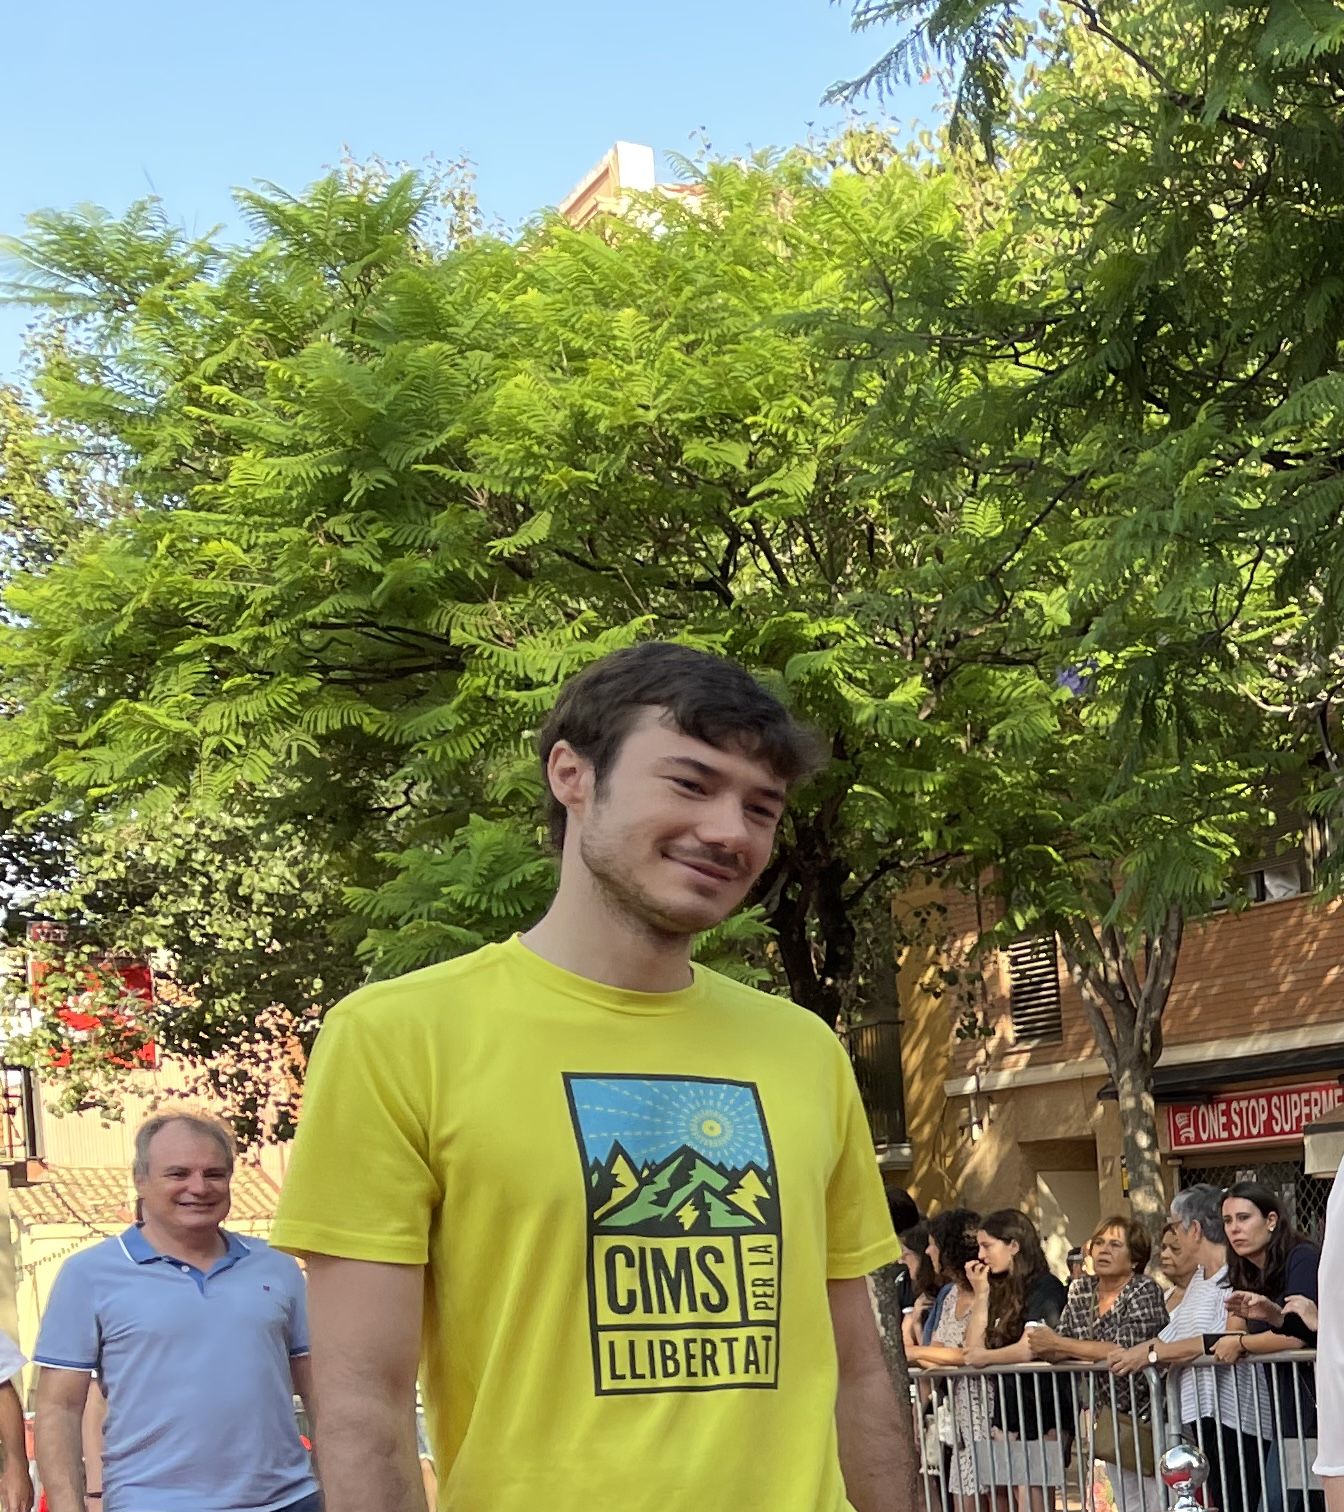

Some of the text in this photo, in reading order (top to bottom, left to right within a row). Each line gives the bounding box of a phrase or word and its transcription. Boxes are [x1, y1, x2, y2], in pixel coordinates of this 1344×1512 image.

[1199, 1101, 1229, 1141] ONE
[1231, 1095, 1269, 1138] STOP
[604, 1244, 729, 1315] CIMS
[747, 1244, 775, 1311] PER LA
[608, 1335, 772, 1380] LLIBERTAT
